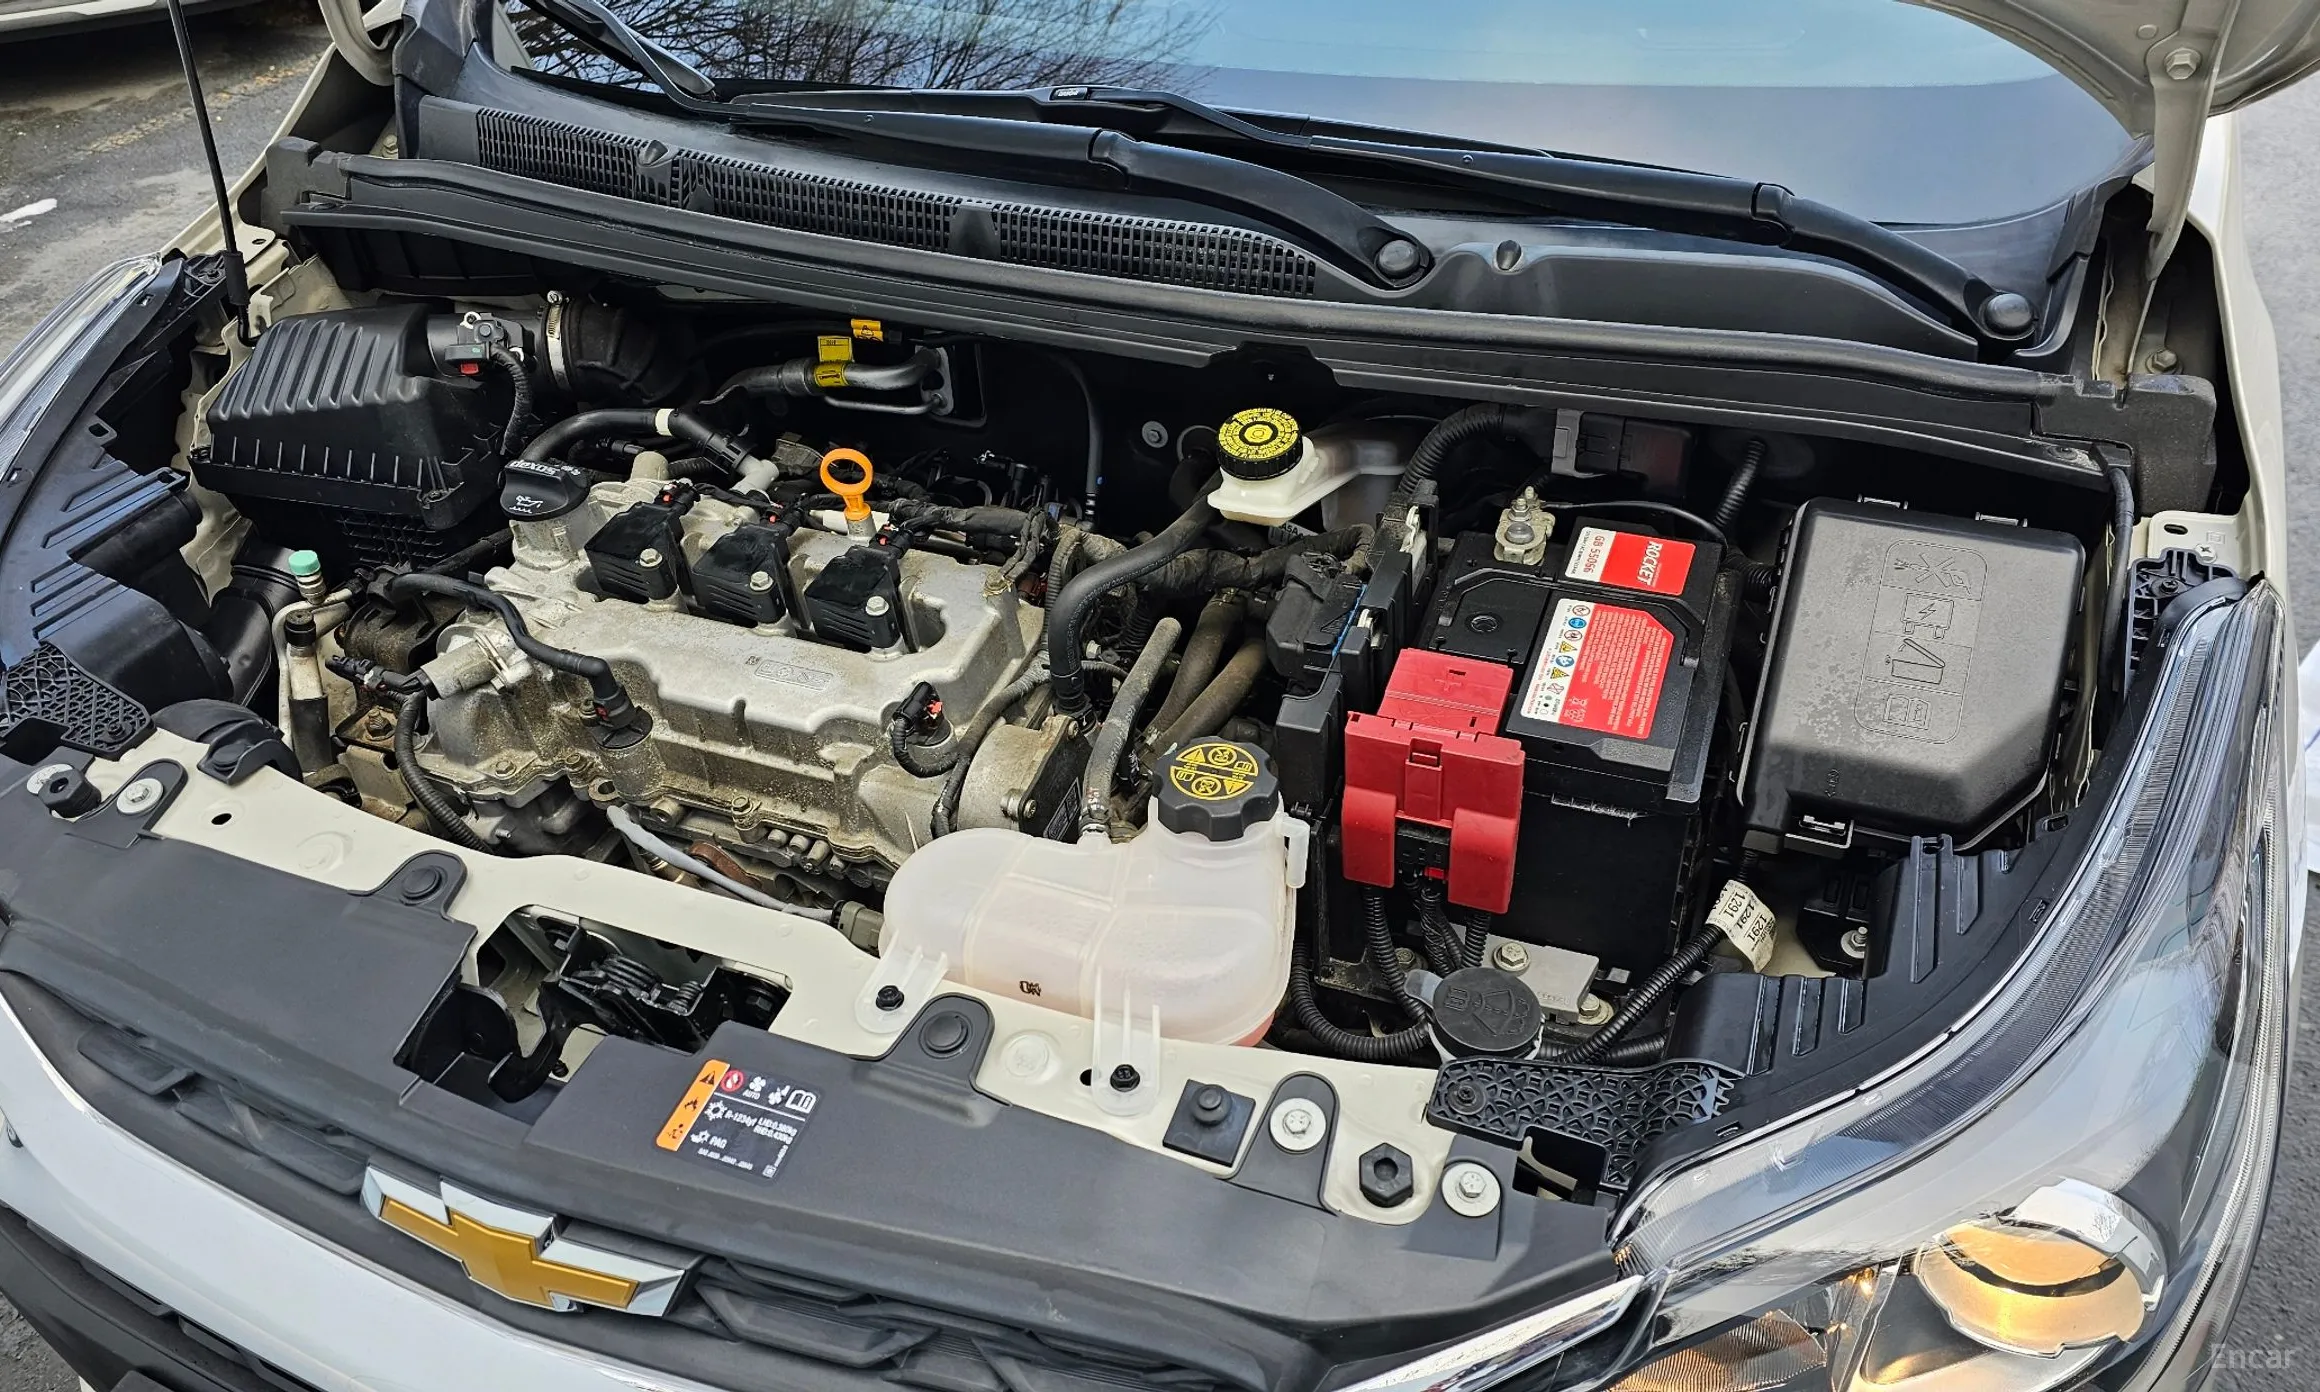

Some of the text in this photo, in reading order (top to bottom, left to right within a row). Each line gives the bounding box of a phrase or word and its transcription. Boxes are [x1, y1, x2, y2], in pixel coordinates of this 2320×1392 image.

[509, 460, 561, 475] dexos
[1636, 542, 1663, 587] ROCKET
[1723, 892, 1746, 918] 1291
[1736, 900, 1755, 929] 1291
[1747, 915, 1767, 942] 1291
[743, 1089, 761, 1100] AUTO
[709, 1136, 728, 1149] PAG
